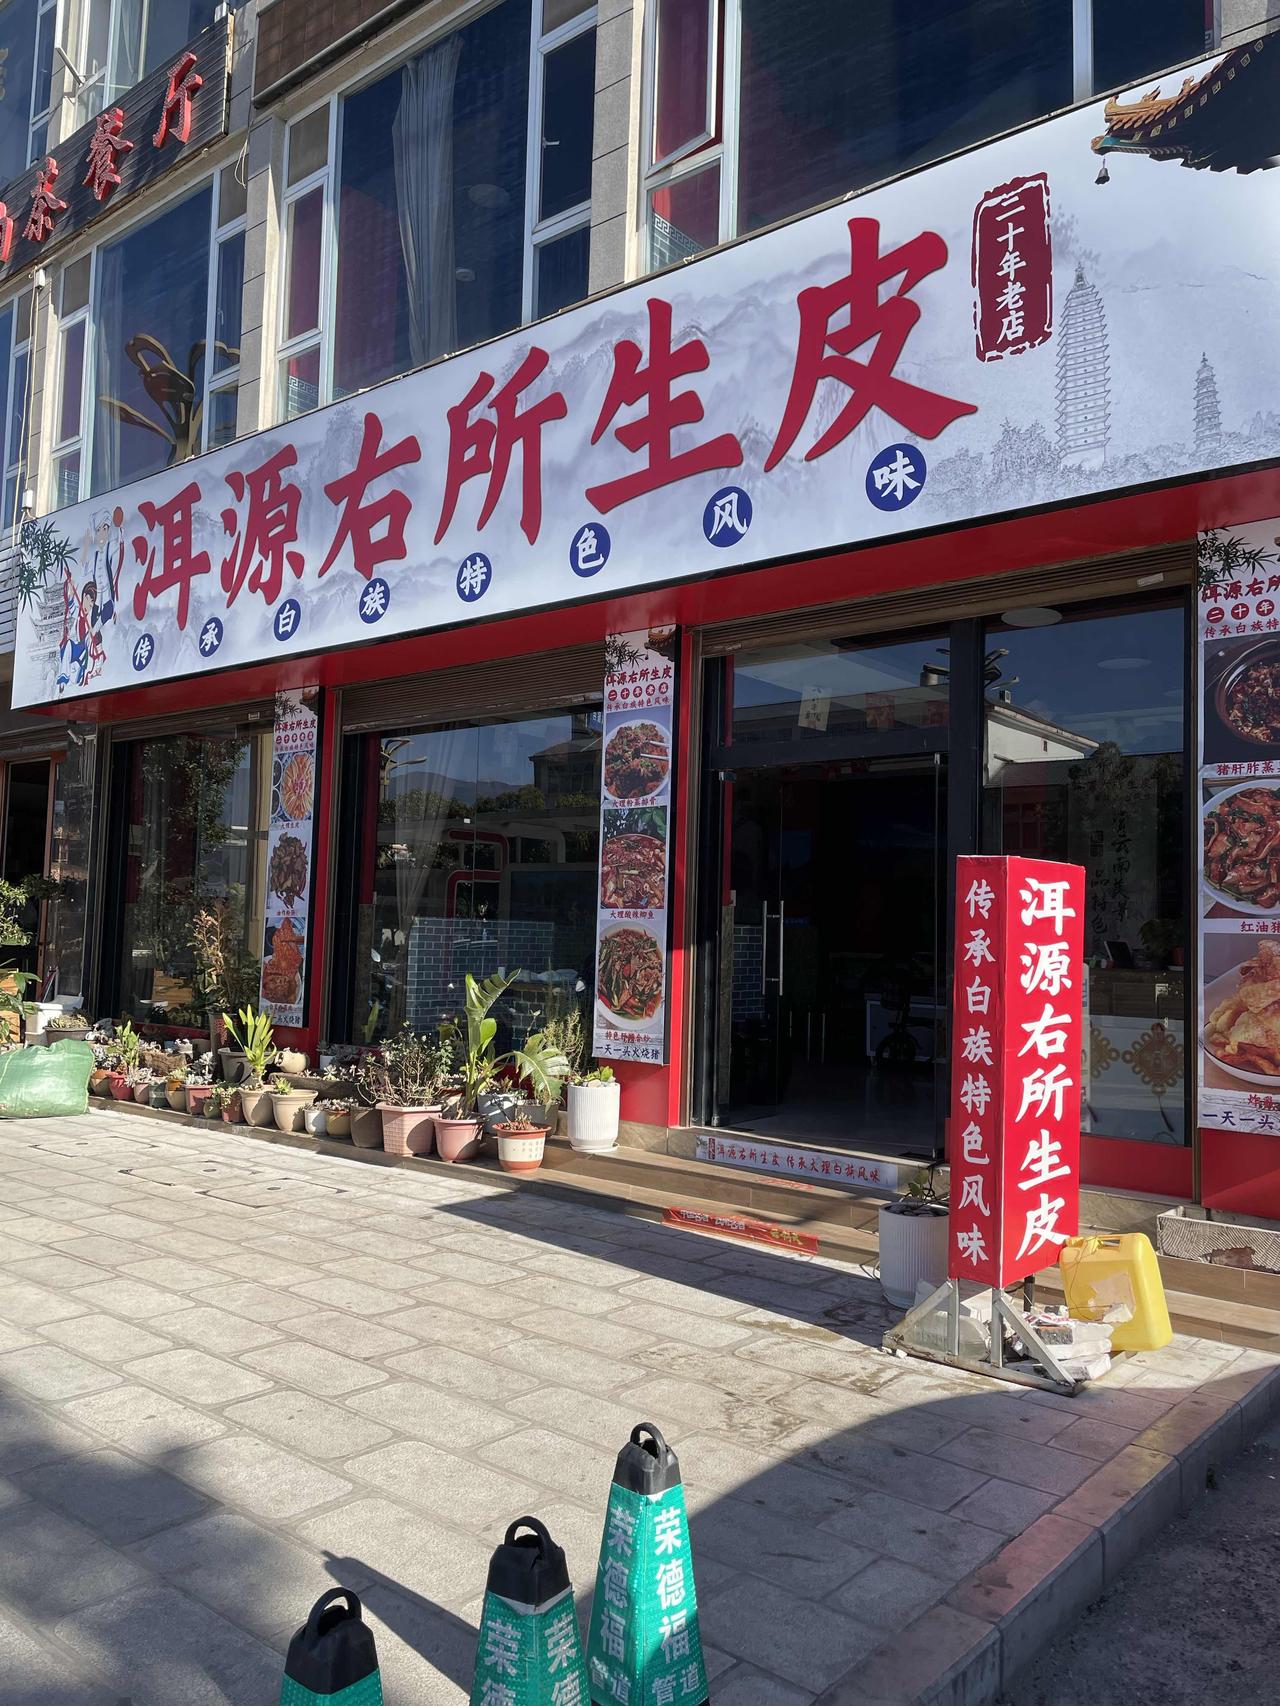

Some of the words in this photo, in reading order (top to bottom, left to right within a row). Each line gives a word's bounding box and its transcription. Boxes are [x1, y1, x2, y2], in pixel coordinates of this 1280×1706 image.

[0, 52, 203, 262] 茶餐厅
[995, 195, 1027, 344] 二十年老店
[131, 217, 978, 632] 洱源右所生皮
[133, 446, 922, 670] 传承白族特色风味
[1204, 617, 1280, 639] 传承白族特
[1216, 759, 1280, 776] 猪肝胙蒸
[595, 1044, 660, 1060] 一天一头火烧猪
[956, 879, 996, 1267] 传承白族特色风味
[1014, 877, 1076, 1262] 洱源右所生皮
[1202, 1111, 1280, 1130] 一天一头
[600, 1506, 637, 1663] 荣德福
[653, 1506, 690, 1665] 荣德福
[589, 1656, 632, 1701] 管道
[651, 1663, 700, 1706] 管道
